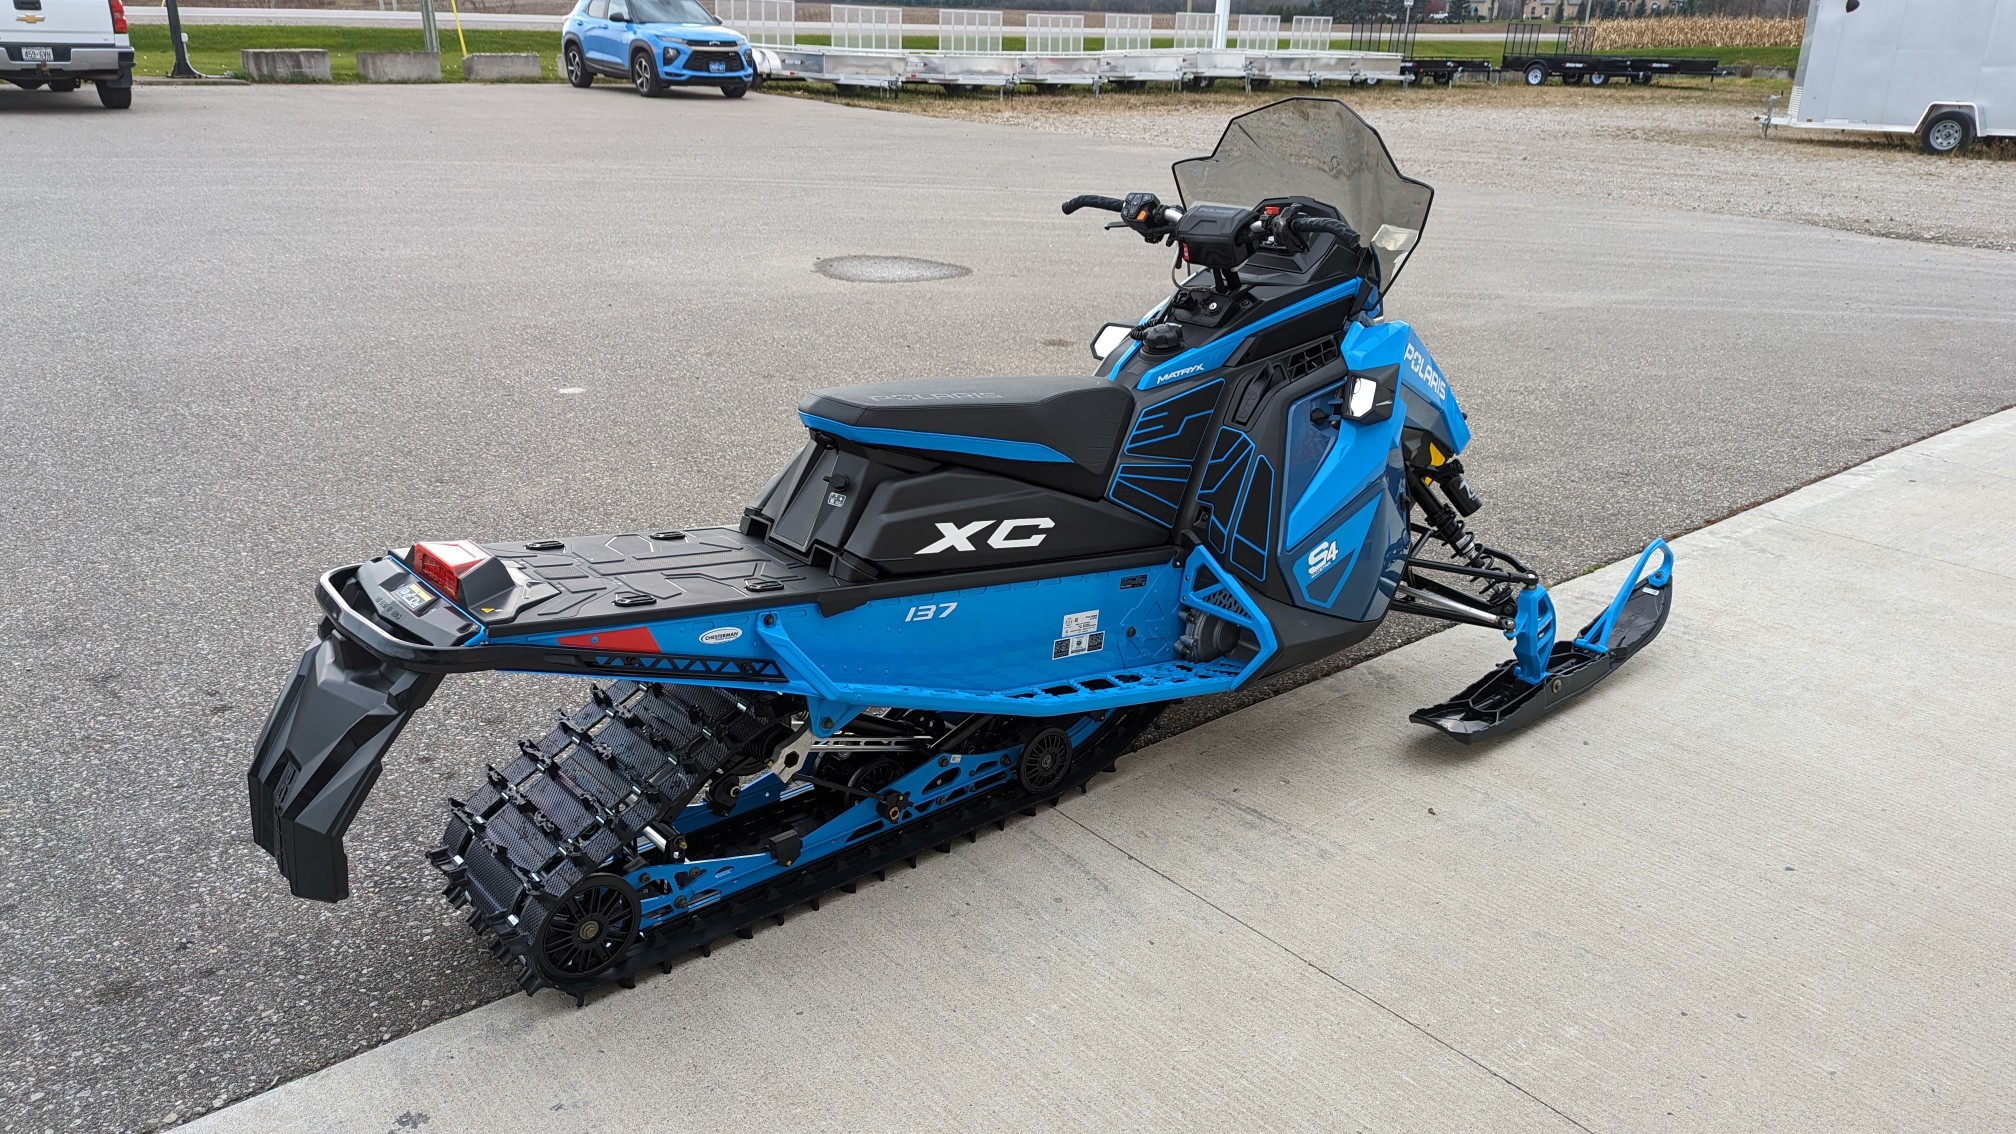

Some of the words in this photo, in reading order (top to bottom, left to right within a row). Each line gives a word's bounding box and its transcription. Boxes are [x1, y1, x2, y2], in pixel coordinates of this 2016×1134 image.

[1156, 363, 1205, 385] MATRYX
[1404, 342, 1446, 401] POLARIS
[868, 391, 1003, 402] POLARIS
[914, 517, 1056, 555] XC
[1308, 540, 1339, 575] S4
[904, 602, 958, 622] 137
[704, 631, 739, 641] CHESTERMAN
